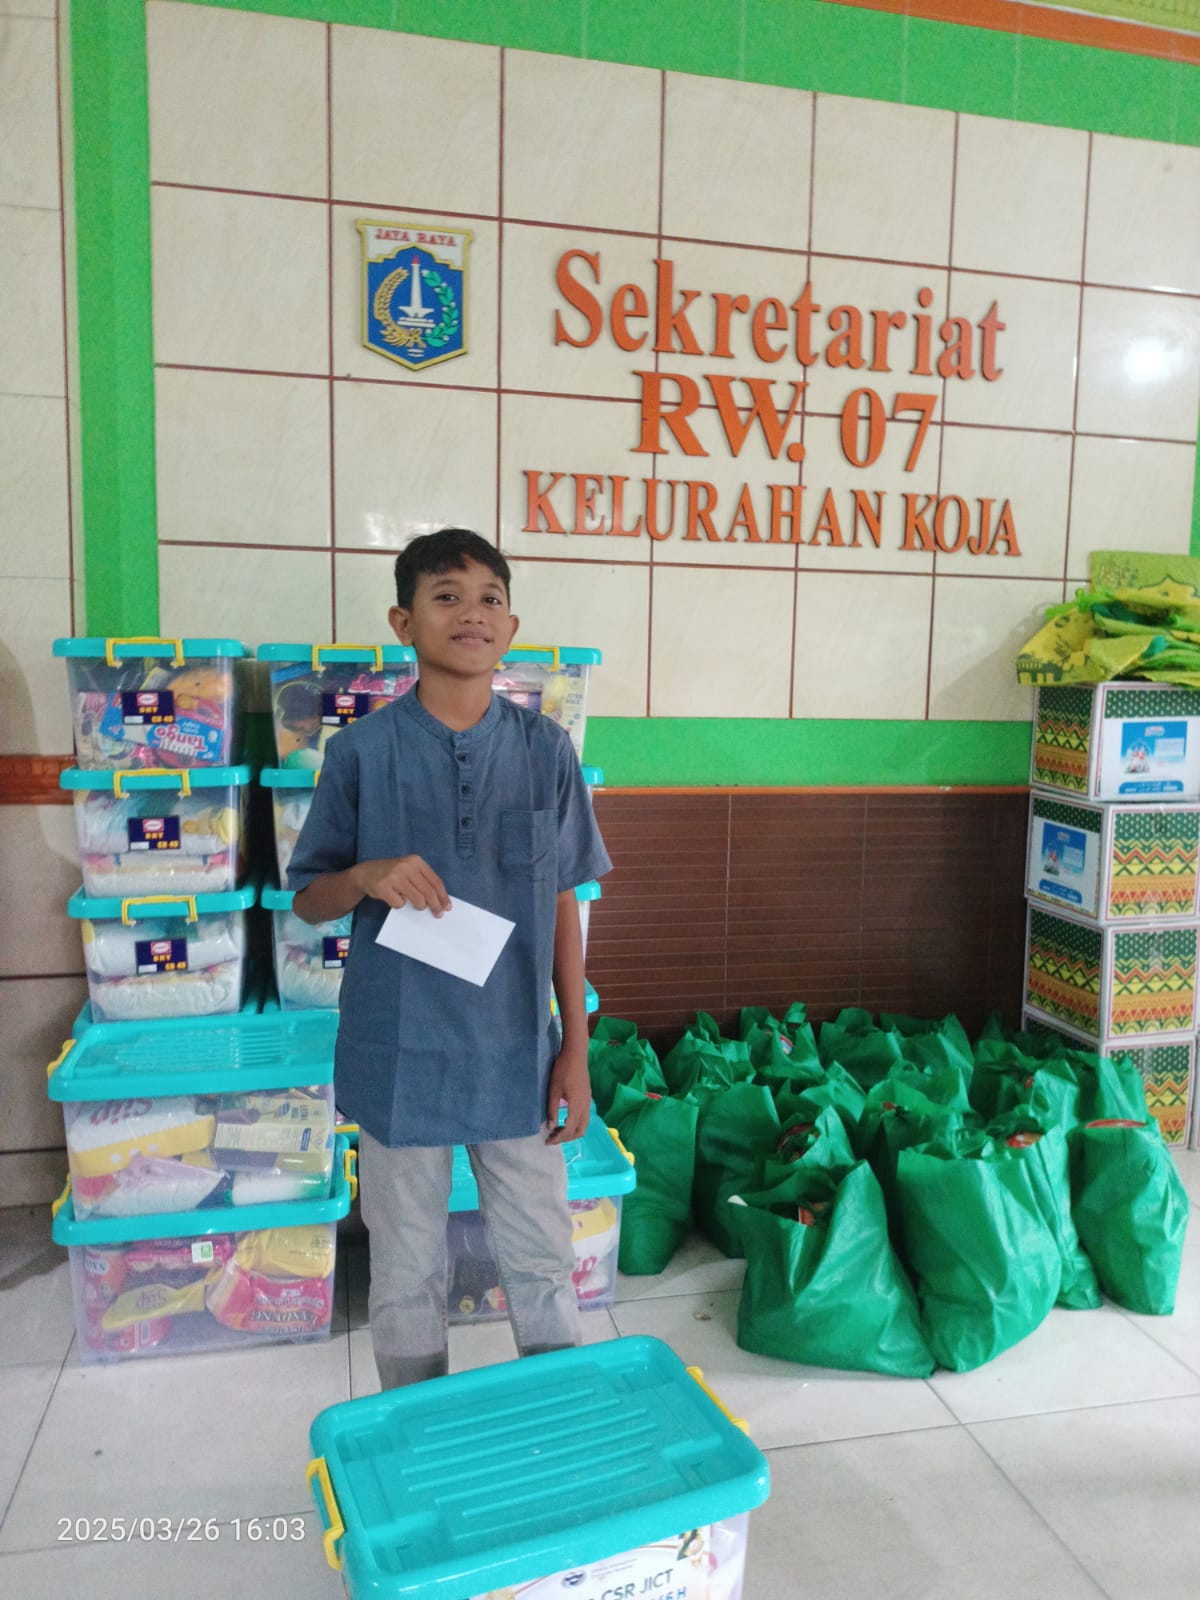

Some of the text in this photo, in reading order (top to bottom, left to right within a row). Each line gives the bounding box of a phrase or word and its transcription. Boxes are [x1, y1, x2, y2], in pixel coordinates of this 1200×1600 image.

[417, 232, 457, 247] RAYA
[554, 249, 1006, 382] Sekretariat
[631, 370, 939, 473] RW. 07
[522, 469, 1023, 557] KELURAHAN KOJA
[154, 724, 209, 753] Tango
[639, 1568, 674, 1594] JICT
